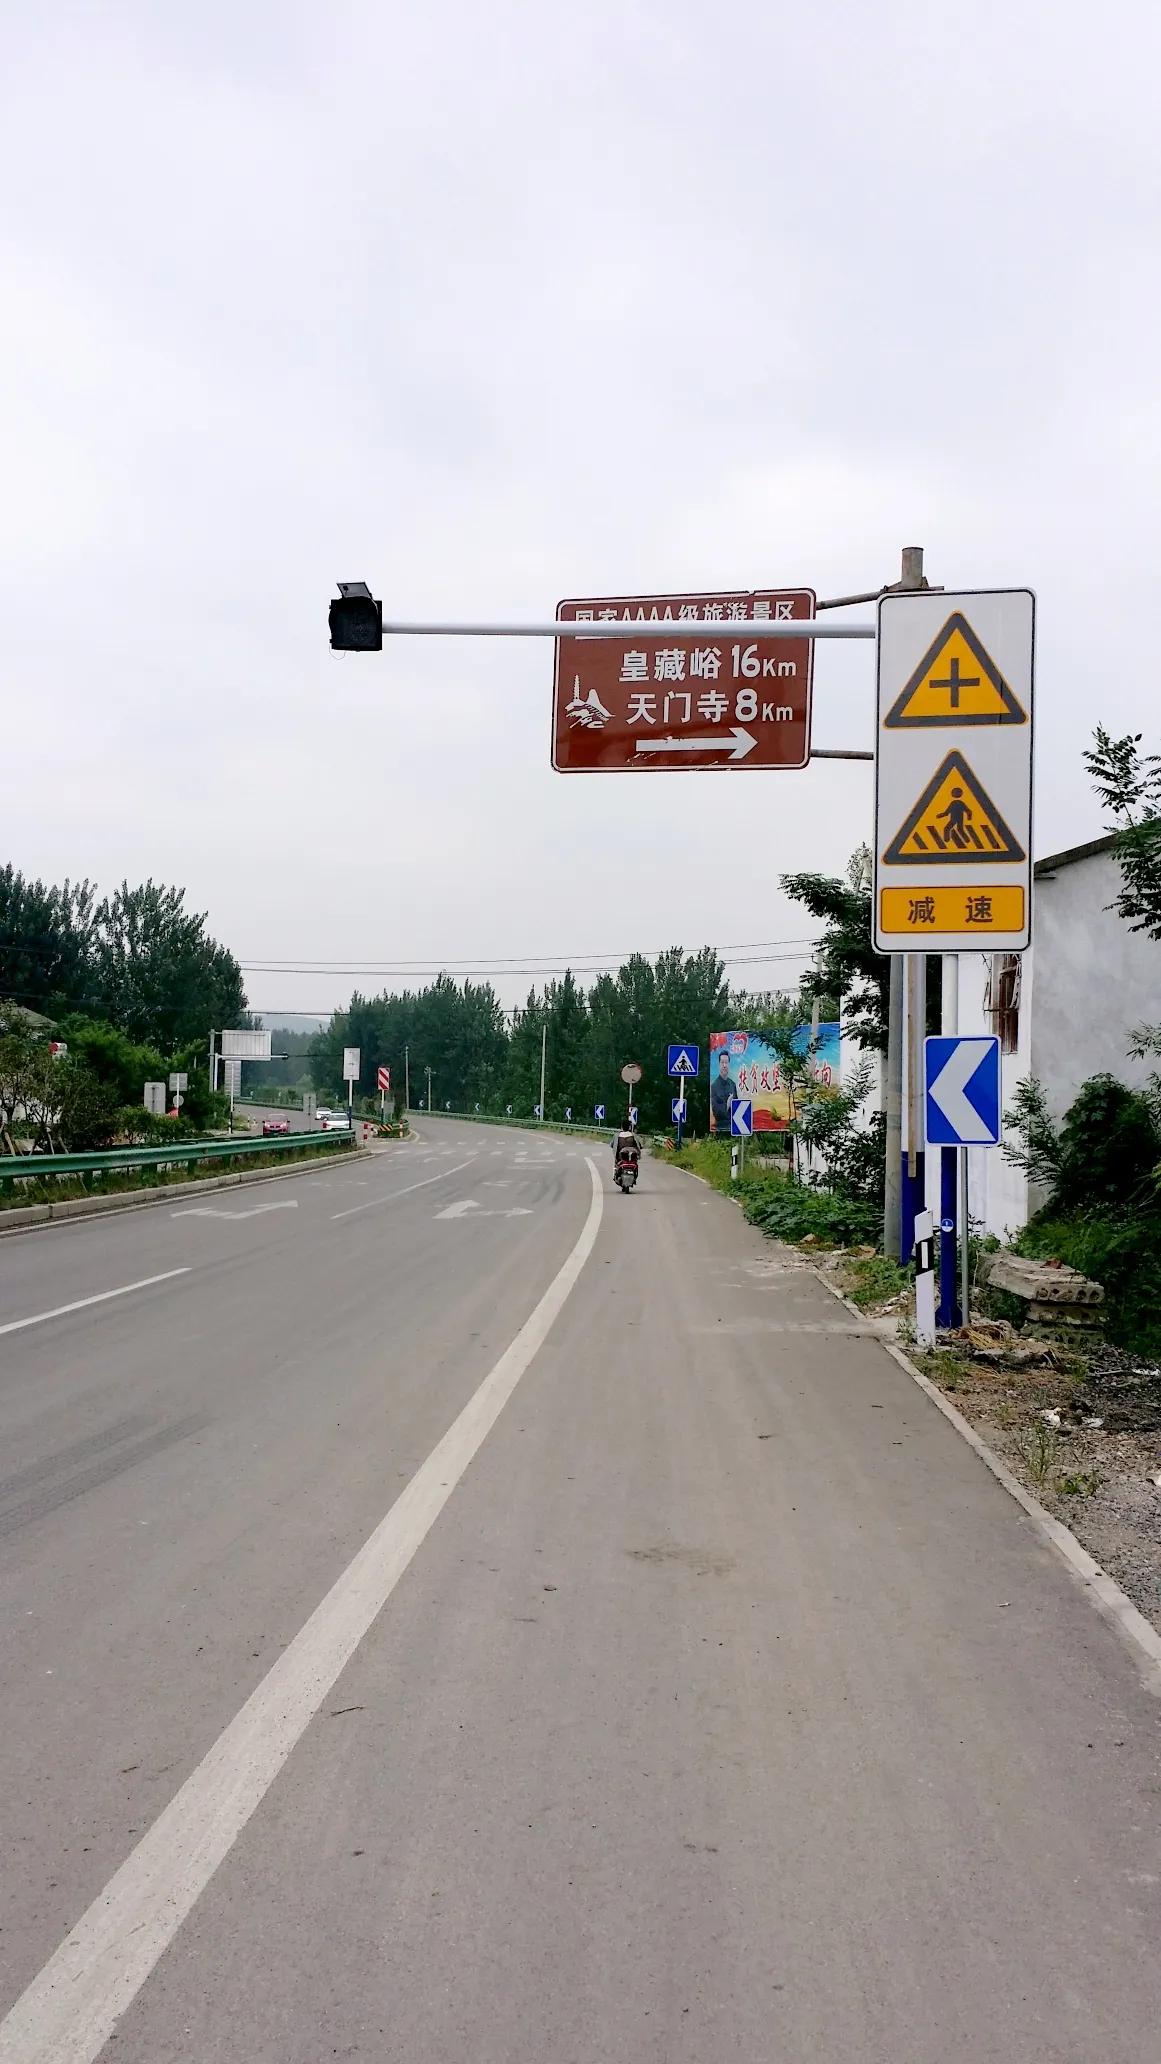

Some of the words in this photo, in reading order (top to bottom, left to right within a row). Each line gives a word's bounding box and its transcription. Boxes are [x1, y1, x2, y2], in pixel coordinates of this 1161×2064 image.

[619, 647, 722, 682] 皇藏峪
[731, 644, 797, 678] 16Km
[626, 689, 729, 725] 天门寺
[908, 896, 993, 924] 减速
